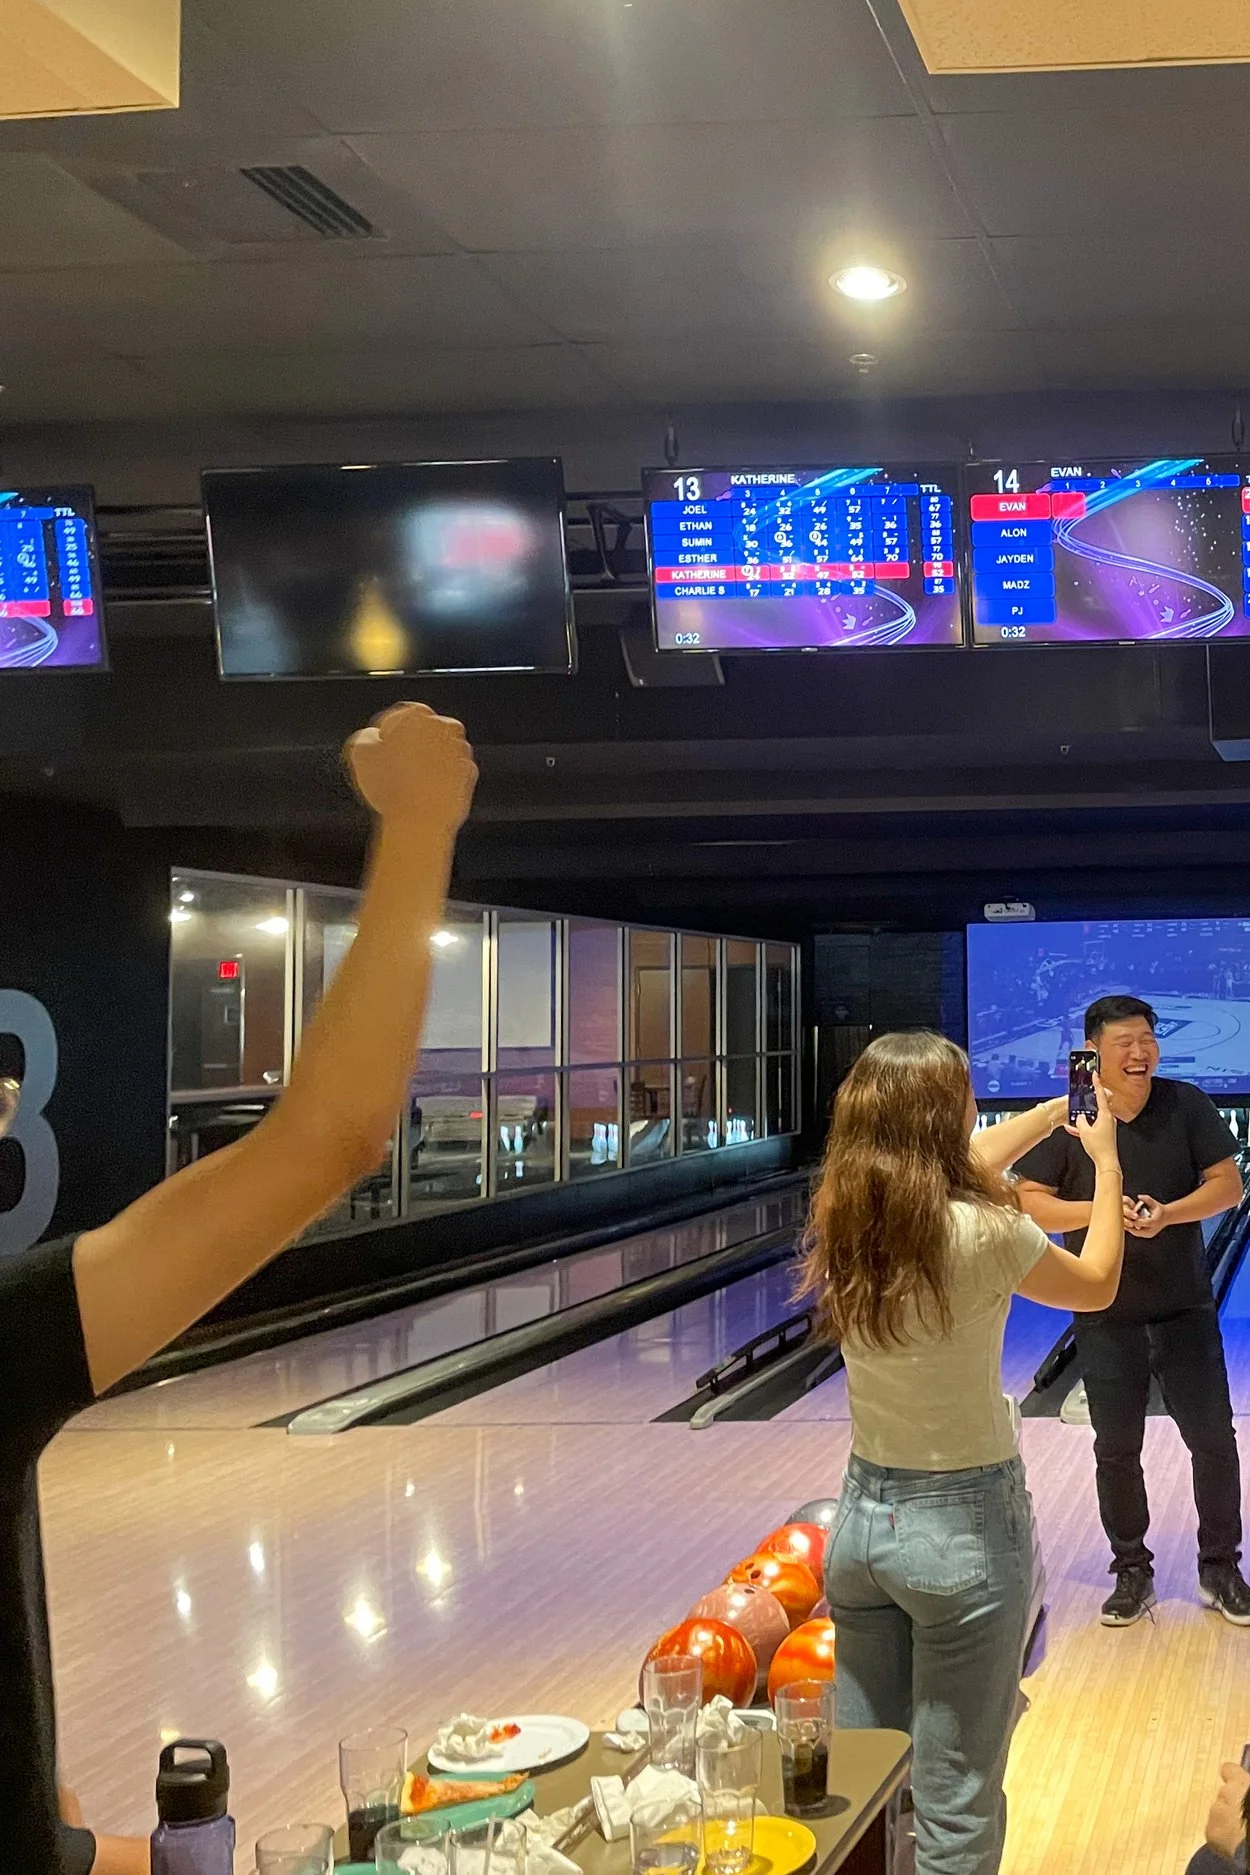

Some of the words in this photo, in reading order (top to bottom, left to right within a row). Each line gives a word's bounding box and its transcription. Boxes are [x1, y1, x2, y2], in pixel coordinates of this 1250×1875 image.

[994, 469, 1019, 494] 14
[1051, 467, 1082, 477] EVAN
[1135, 480, 1141, 488] 3
[1170, 479, 1176, 487] 4
[674, 477, 700, 501] 13
[731, 474, 795, 485] KATHERINE
[920, 484, 941, 493] TTL
[682, 505, 707, 515] JOEL
[743, 508, 756, 516] 24
[813, 506, 827, 514] 49
[848, 506, 861, 514] 57
[929, 504, 941, 512] 67
[999, 502, 1026, 511] EVAN
[54, 507, 76, 517] TTL
[680, 522, 712, 531] ETHAN
[814, 523, 827, 531] 26
[849, 522, 862, 530] 35
[884, 521, 897, 529] 36
[930, 520, 941, 528] 36
[1000, 528, 1027, 537] ALON
[682, 538, 712, 547] SUMIN
[885, 538, 898, 546] 57
[678, 554, 717, 563] ESTHER
[886, 554, 898, 562] 70
[931, 553, 943, 561] 70
[996, 554, 1034, 564] JAYDEN
[671, 570, 727, 580] KATHERINE
[1002, 580, 1030, 589] MADZ
[674, 586, 716, 596] CHARLIE
[749, 589, 759, 597] 17
[784, 588, 795, 596] 21
[853, 587, 865, 595] 35
[933, 585, 944, 593] 35
[1011, 606, 1024, 616] PJ
[1000, 627, 1026, 638] 0:32
[675, 633, 700, 644] 0:32
